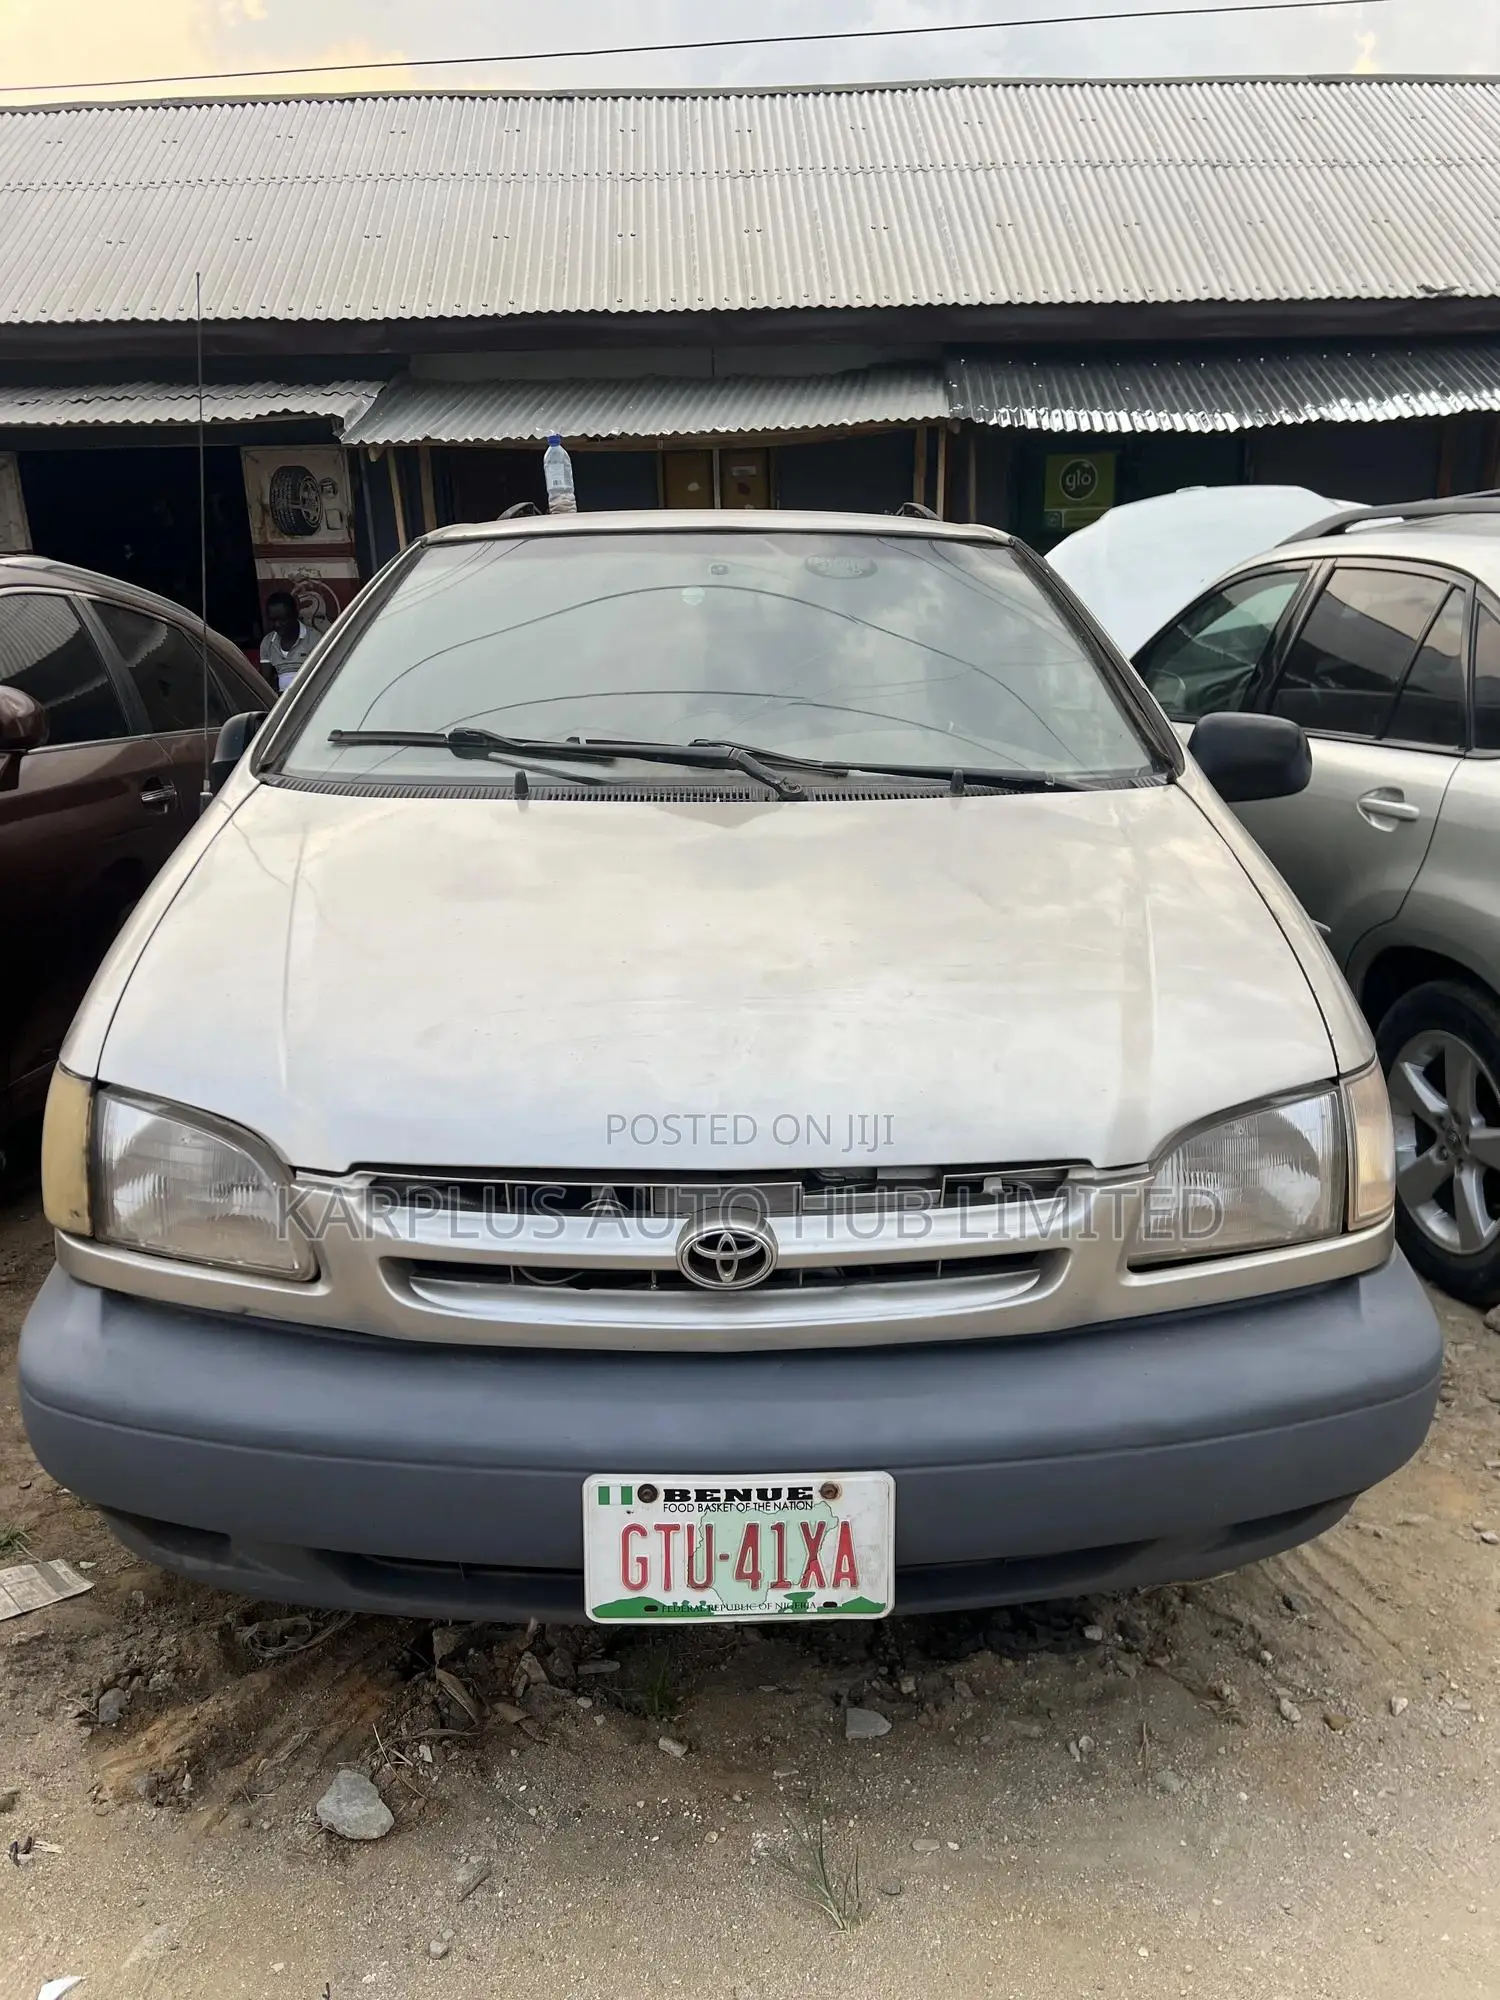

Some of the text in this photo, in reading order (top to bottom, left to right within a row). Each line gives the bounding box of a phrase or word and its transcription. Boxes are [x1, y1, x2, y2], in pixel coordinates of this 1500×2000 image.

[1066, 469, 1091, 491] glo
[663, 1487, 813, 1502] BENUE
[663, 1501, 813, 1513] FOOD BASKET OF THE NATION
[620, 1520, 859, 1592] GTU-41XA
[662, 1601, 816, 1613] FEDERAL REPUBLIC OF NIGERIA
